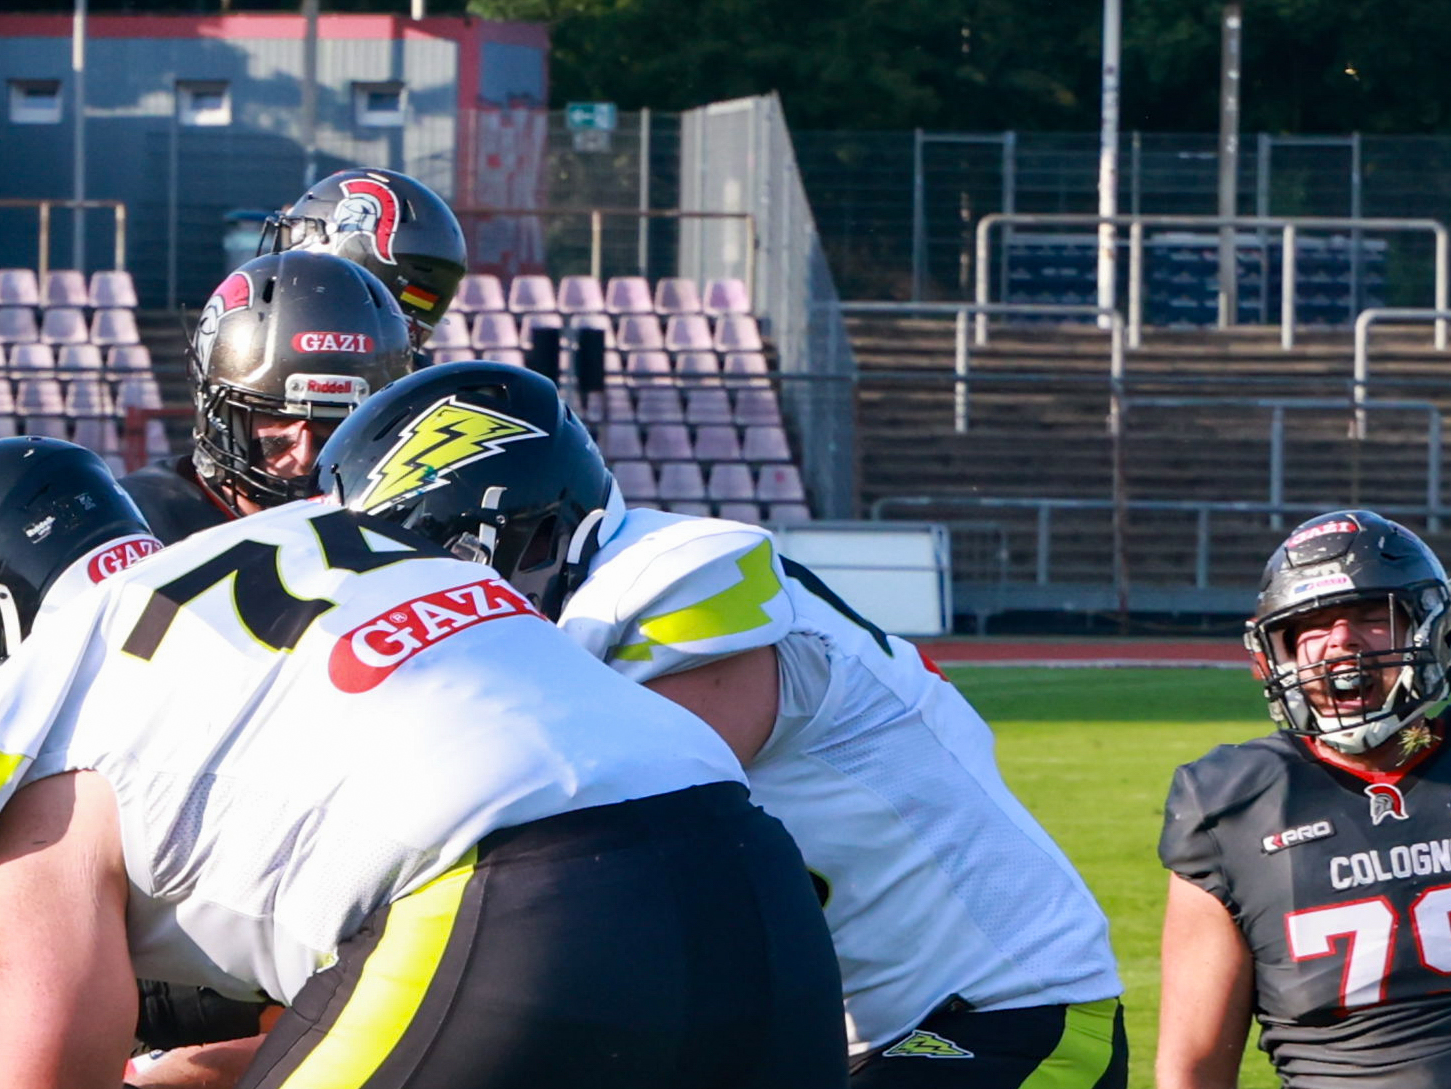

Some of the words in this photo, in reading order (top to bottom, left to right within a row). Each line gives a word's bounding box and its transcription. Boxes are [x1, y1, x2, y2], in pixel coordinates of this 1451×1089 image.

[301, 333, 367, 353] GAZI
[307, 380, 352, 393] Riddell
[98, 540, 164, 578] GAZ
[1330, 838, 1451, 890] COLOGN
